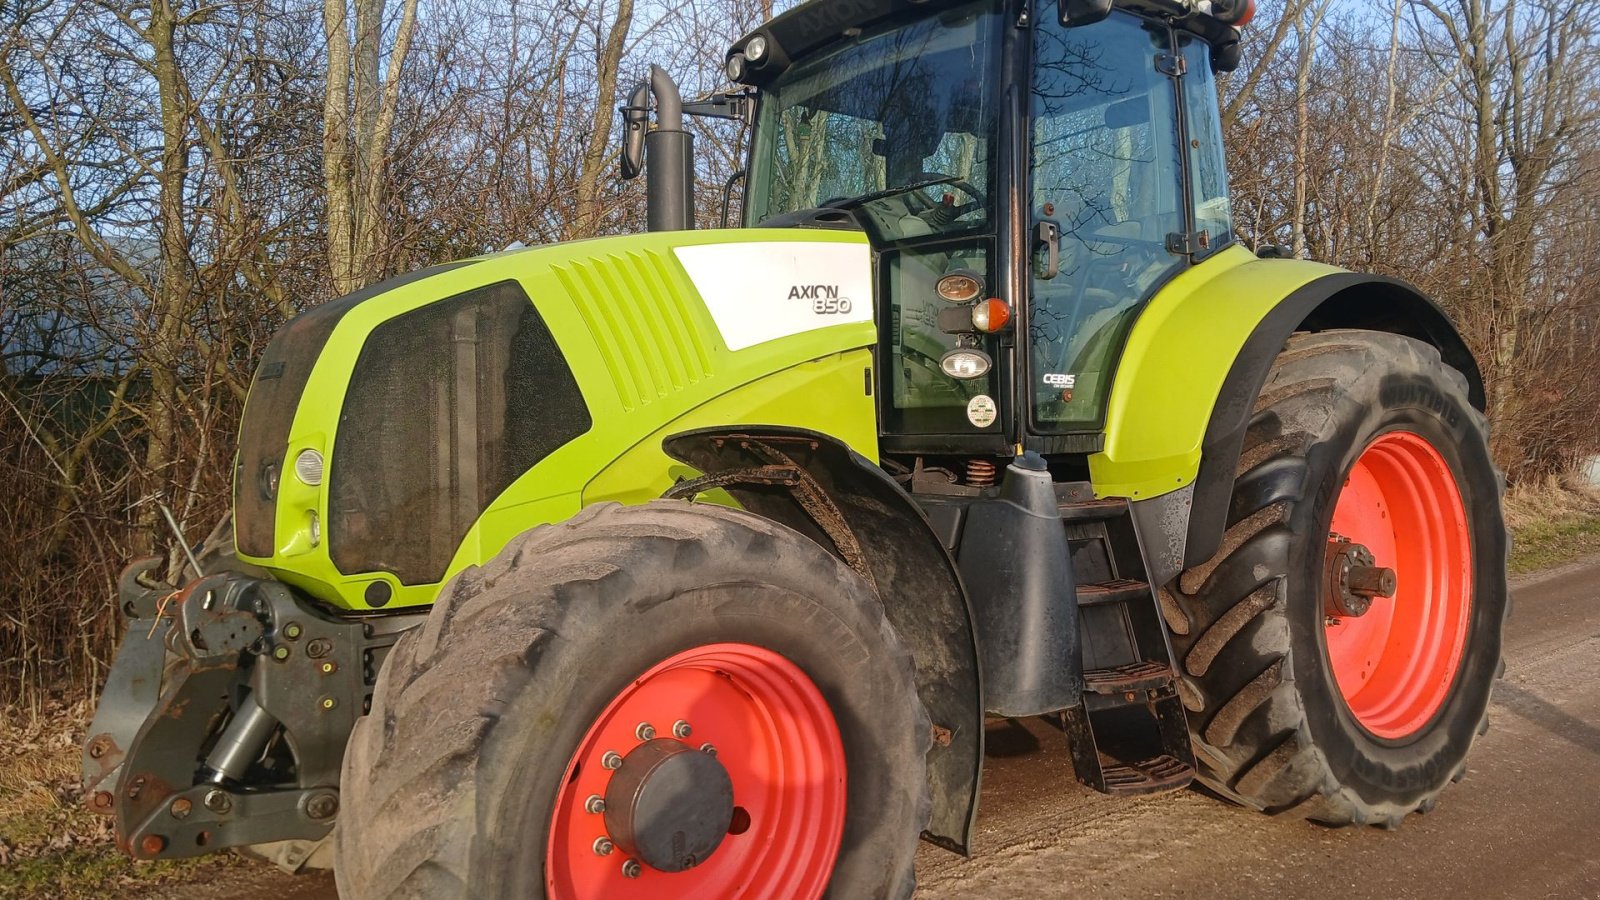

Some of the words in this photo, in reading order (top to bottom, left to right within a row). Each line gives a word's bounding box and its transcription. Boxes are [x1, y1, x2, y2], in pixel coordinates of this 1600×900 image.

[788, 285, 839, 300] AXION
[813, 297, 852, 314] 850
[1043, 373, 1076, 385] CEBIS
